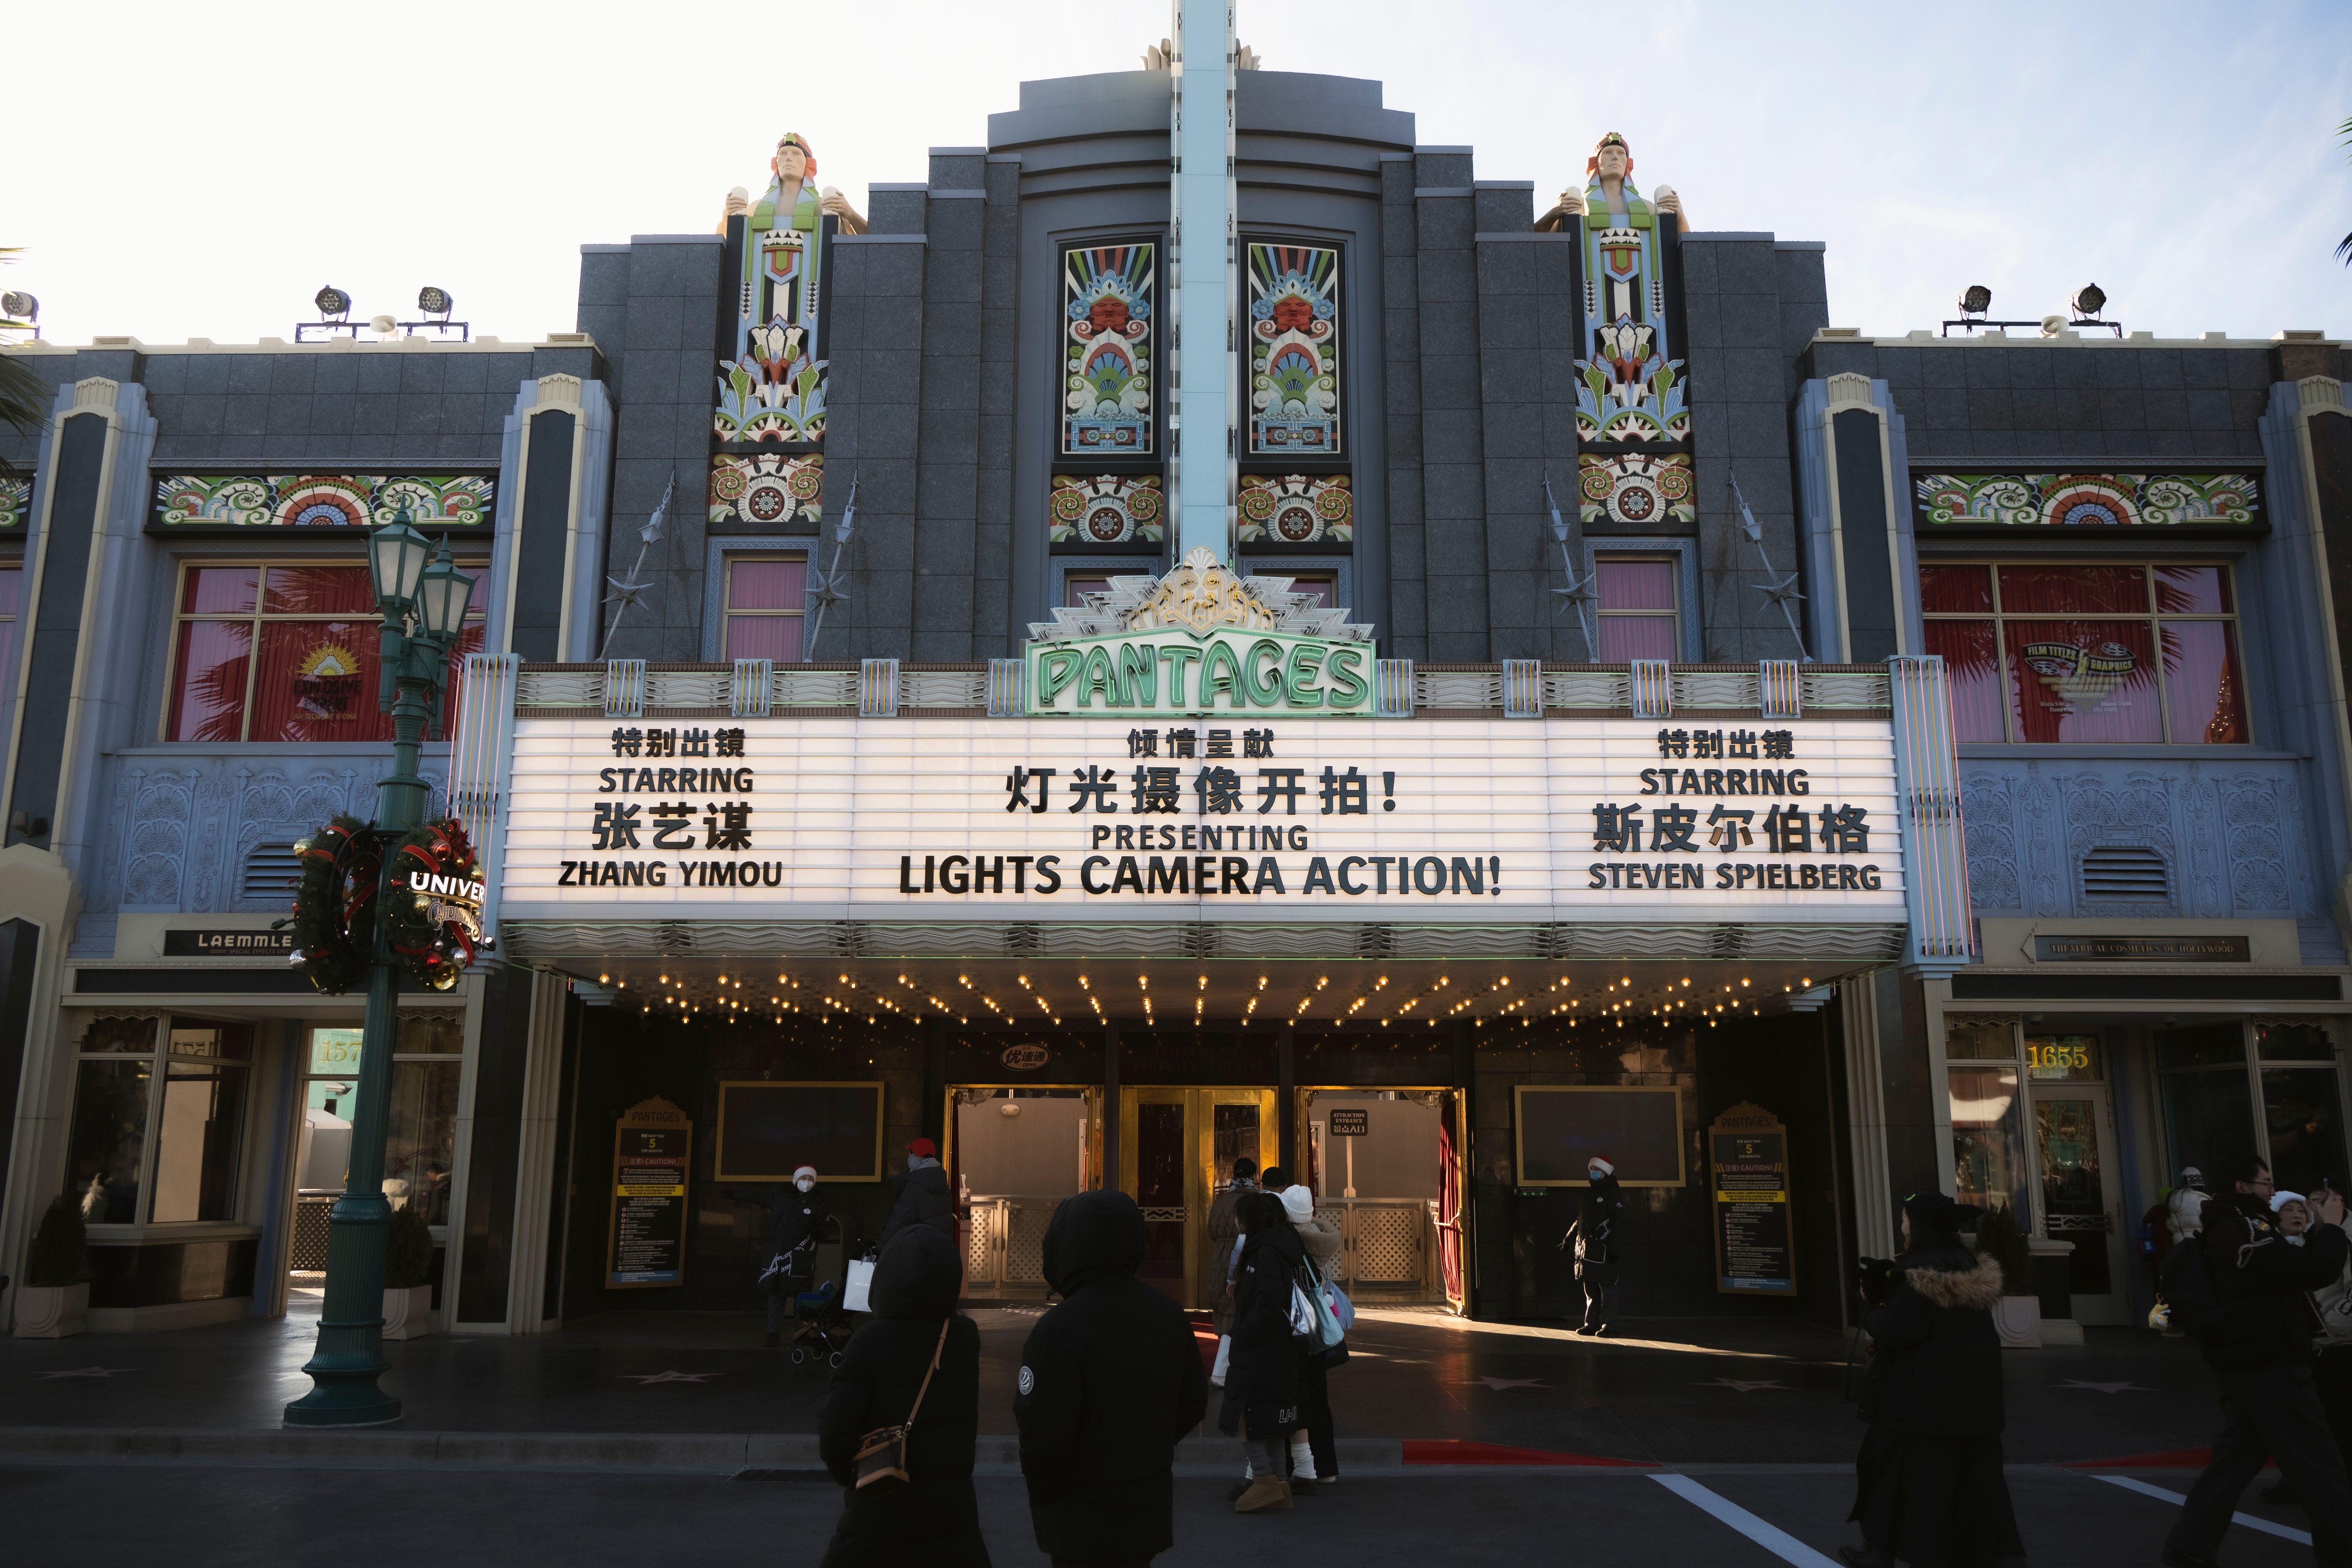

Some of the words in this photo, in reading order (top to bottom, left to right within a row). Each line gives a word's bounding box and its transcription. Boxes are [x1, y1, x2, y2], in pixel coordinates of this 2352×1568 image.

[2027, 646, 2047, 656] FILM
[2048, 646, 2076, 661] TITLES
[2091, 659, 2133, 670] GRAPHICS
[1039, 639, 1368, 708] PANTAGES
[294, 680, 362, 694] EXPLOSIVE
[304, 697, 349, 711] EXPERT
[611, 727, 745, 758] 特别出镜
[1127, 728, 1274, 759] 倾情呈献
[1658, 728, 1794, 760] 特别出镜
[598, 767, 754, 793] STARRING
[1640, 768, 1809, 796] STARRING
[592, 801, 753, 851] 张艺谋
[1092, 825, 1307, 850] PRESENTING
[1593, 802, 1870, 854] 斯皮尔伯格
[558, 861, 666, 886] ZHANG
[679, 861, 782, 886] YIMOU
[900, 855, 1061, 894] LIGHTS
[1081, 856, 1286, 895] CAMERA
[1302, 856, 1501, 896] ACTION!
[1589, 863, 1704, 889] STEVEN
[1716, 863, 1881, 890] SPIELBERG
[199, 934, 292, 947] LAEMMLE
[1006, 1050, 1046, 1064] 优速通
[2028, 1046, 2088, 1068] 1655
[632, 1111, 680, 1122] PANTAGES
[1721, 1116, 1771, 1127] PANTAGES
[649, 1138, 656, 1148] 5
[1746, 1144, 1752, 1154] 5
